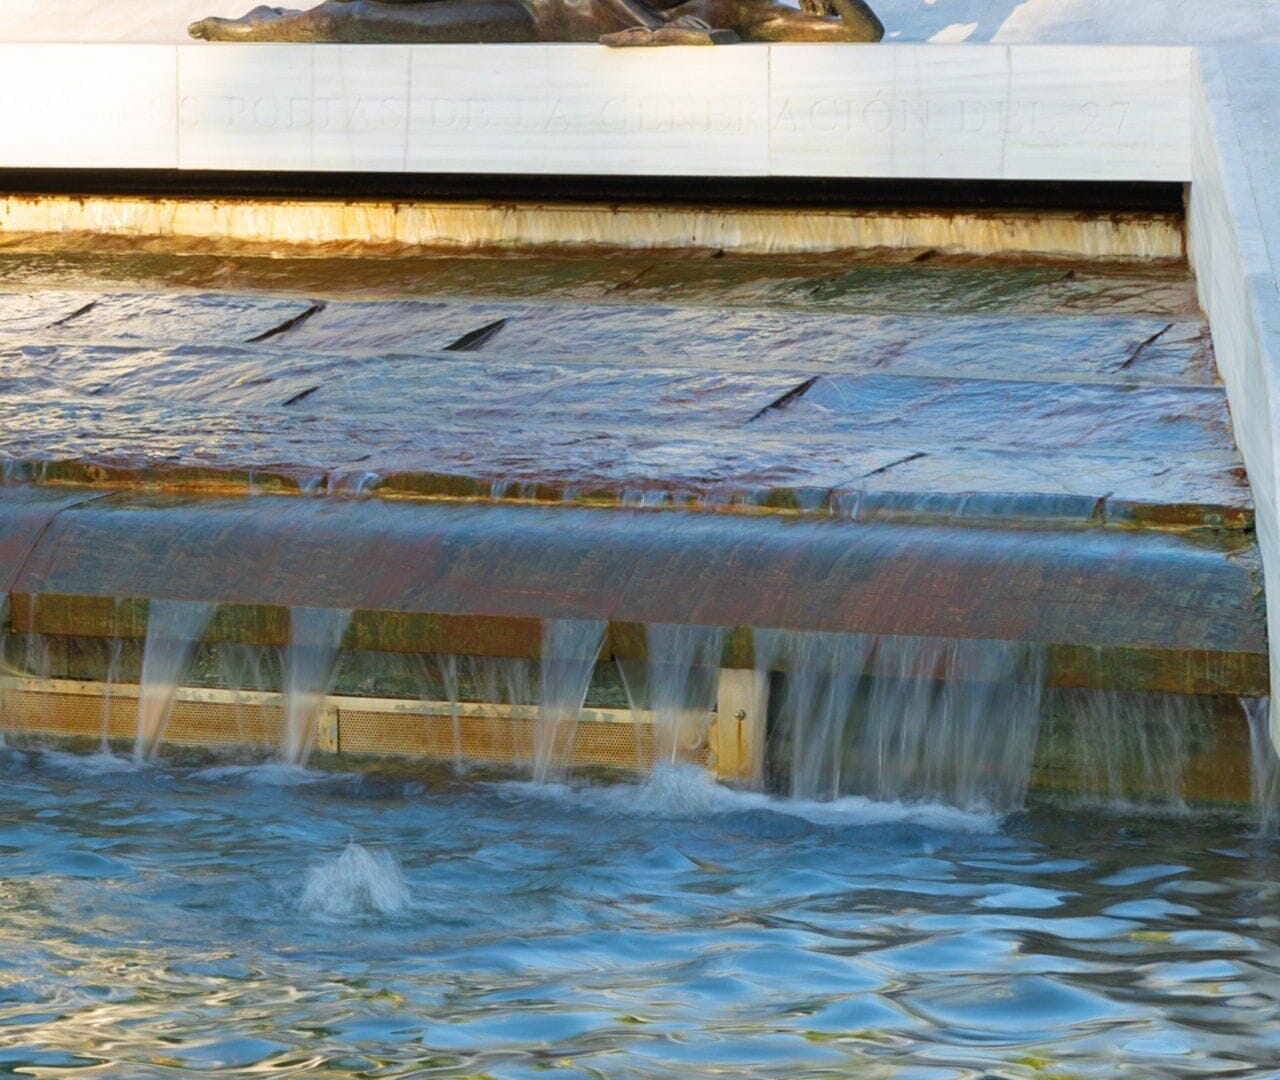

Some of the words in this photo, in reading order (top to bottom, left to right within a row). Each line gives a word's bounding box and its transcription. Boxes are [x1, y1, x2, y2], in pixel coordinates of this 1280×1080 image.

[225, 95, 403, 129] POETAS
[430, 96, 492, 130] DE
[513, 98, 571, 131] LA
[1080, 101, 1132, 135] 27
